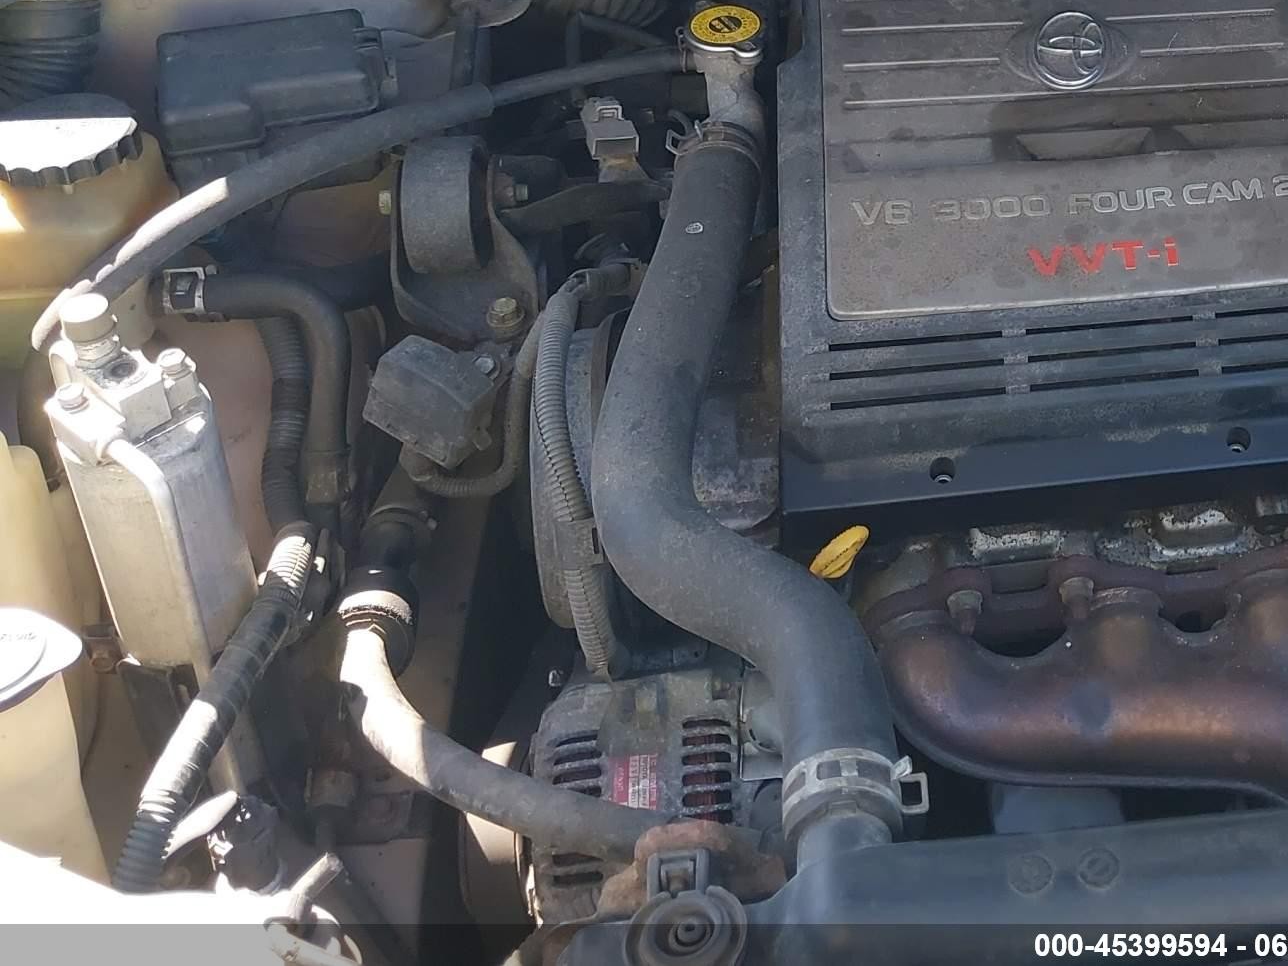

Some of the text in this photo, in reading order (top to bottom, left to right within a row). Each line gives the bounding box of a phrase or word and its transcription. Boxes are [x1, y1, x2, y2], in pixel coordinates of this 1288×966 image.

[851, 199, 914, 226] V6
[931, 194, 1051, 221] 3000
[1069, 186, 1176, 215] FOUR
[1183, 177, 1265, 205] CAM
[1027, 237, 1180, 277] VVT-i
